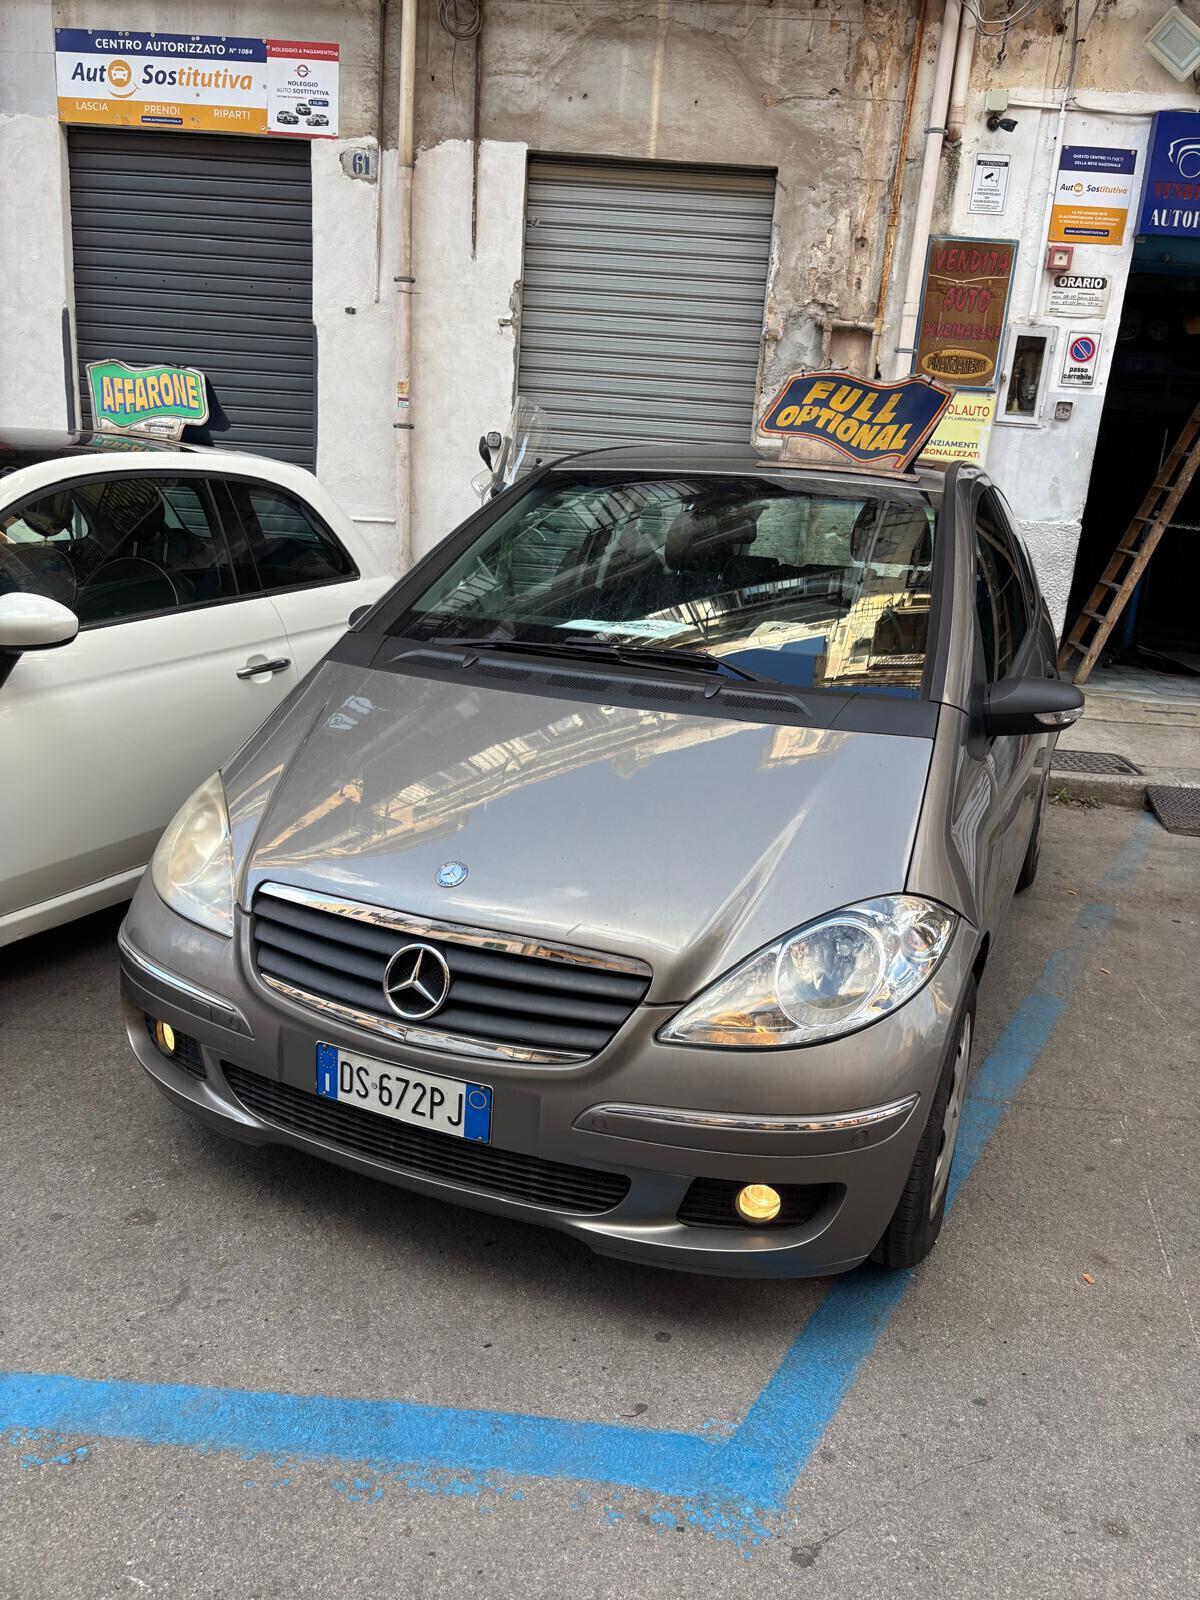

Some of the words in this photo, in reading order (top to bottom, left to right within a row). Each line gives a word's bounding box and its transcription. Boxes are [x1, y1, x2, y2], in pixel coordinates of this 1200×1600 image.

[95, 38, 142, 51] CENTRO
[145, 41, 226, 55] AUTORIZZATO
[141, 64, 253, 90] Sostitutiva
[287, 80, 319, 88] NOLEGGIO
[76, 101, 108, 111] LASCIA
[144, 104, 180, 116] PRENDI
[213, 109, 250, 120] RIPARTI
[353, 153, 370, 175] 61
[1086, 184, 1128, 195] Sostitutiva
[934, 247, 1010, 277] VENDITA
[1059, 277, 1103, 288] ORARIO
[942, 287, 991, 314] AUTO
[101, 373, 200, 414] AFFARONE
[801, 380, 903, 424] FULL
[947, 404, 990, 417] OLAUTO
[776, 405, 913, 451] OPTIONAL
[922, 448, 980, 458] SONALIZZATI
[325, 1072, 330, 1092] I
